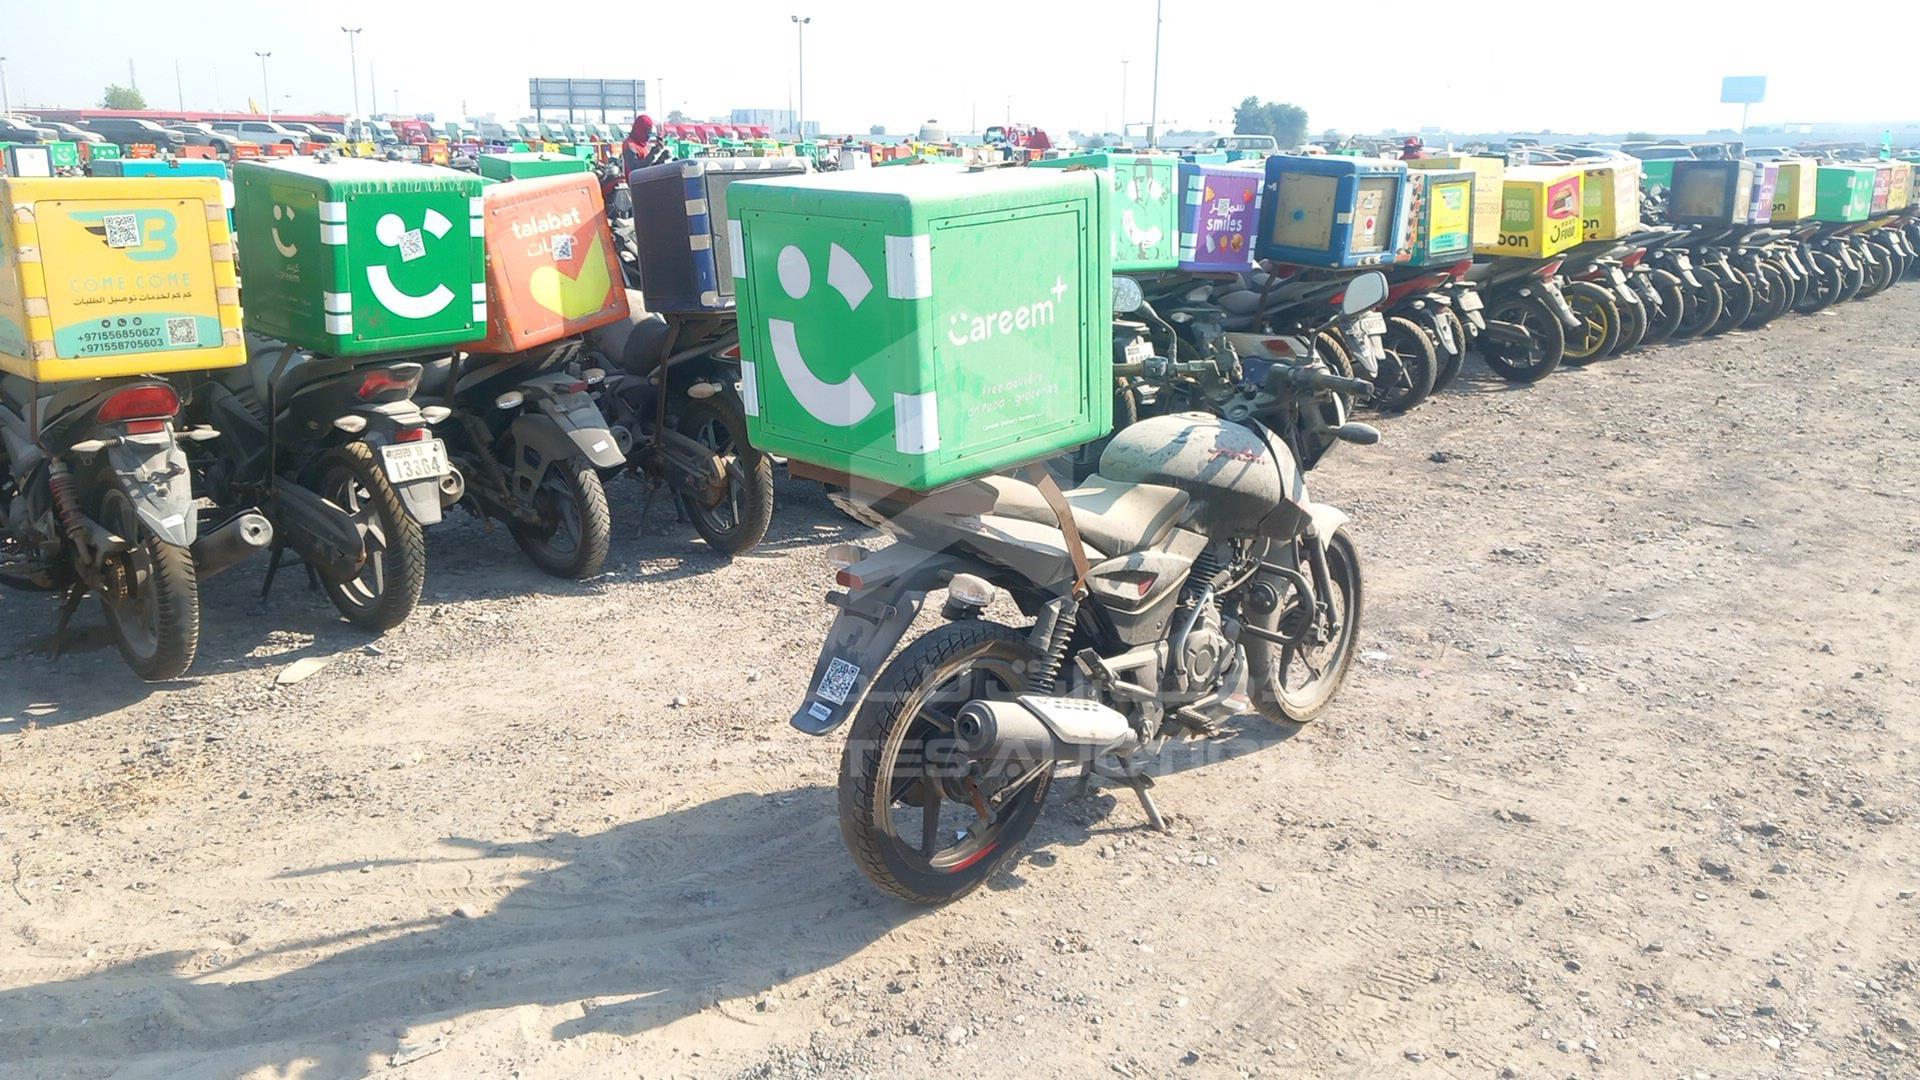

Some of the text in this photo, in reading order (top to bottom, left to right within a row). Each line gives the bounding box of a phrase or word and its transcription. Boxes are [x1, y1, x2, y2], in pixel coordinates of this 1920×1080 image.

[511, 207, 581, 240] talabat
[1206, 214, 1243, 232] smiles
[1497, 234, 1529, 248] oon
[70, 271, 190, 293] COME COME
[78, 327, 161, 342] +971556850627
[80, 338, 164, 353] +971558705603
[395, 456, 441, 479] 13364
